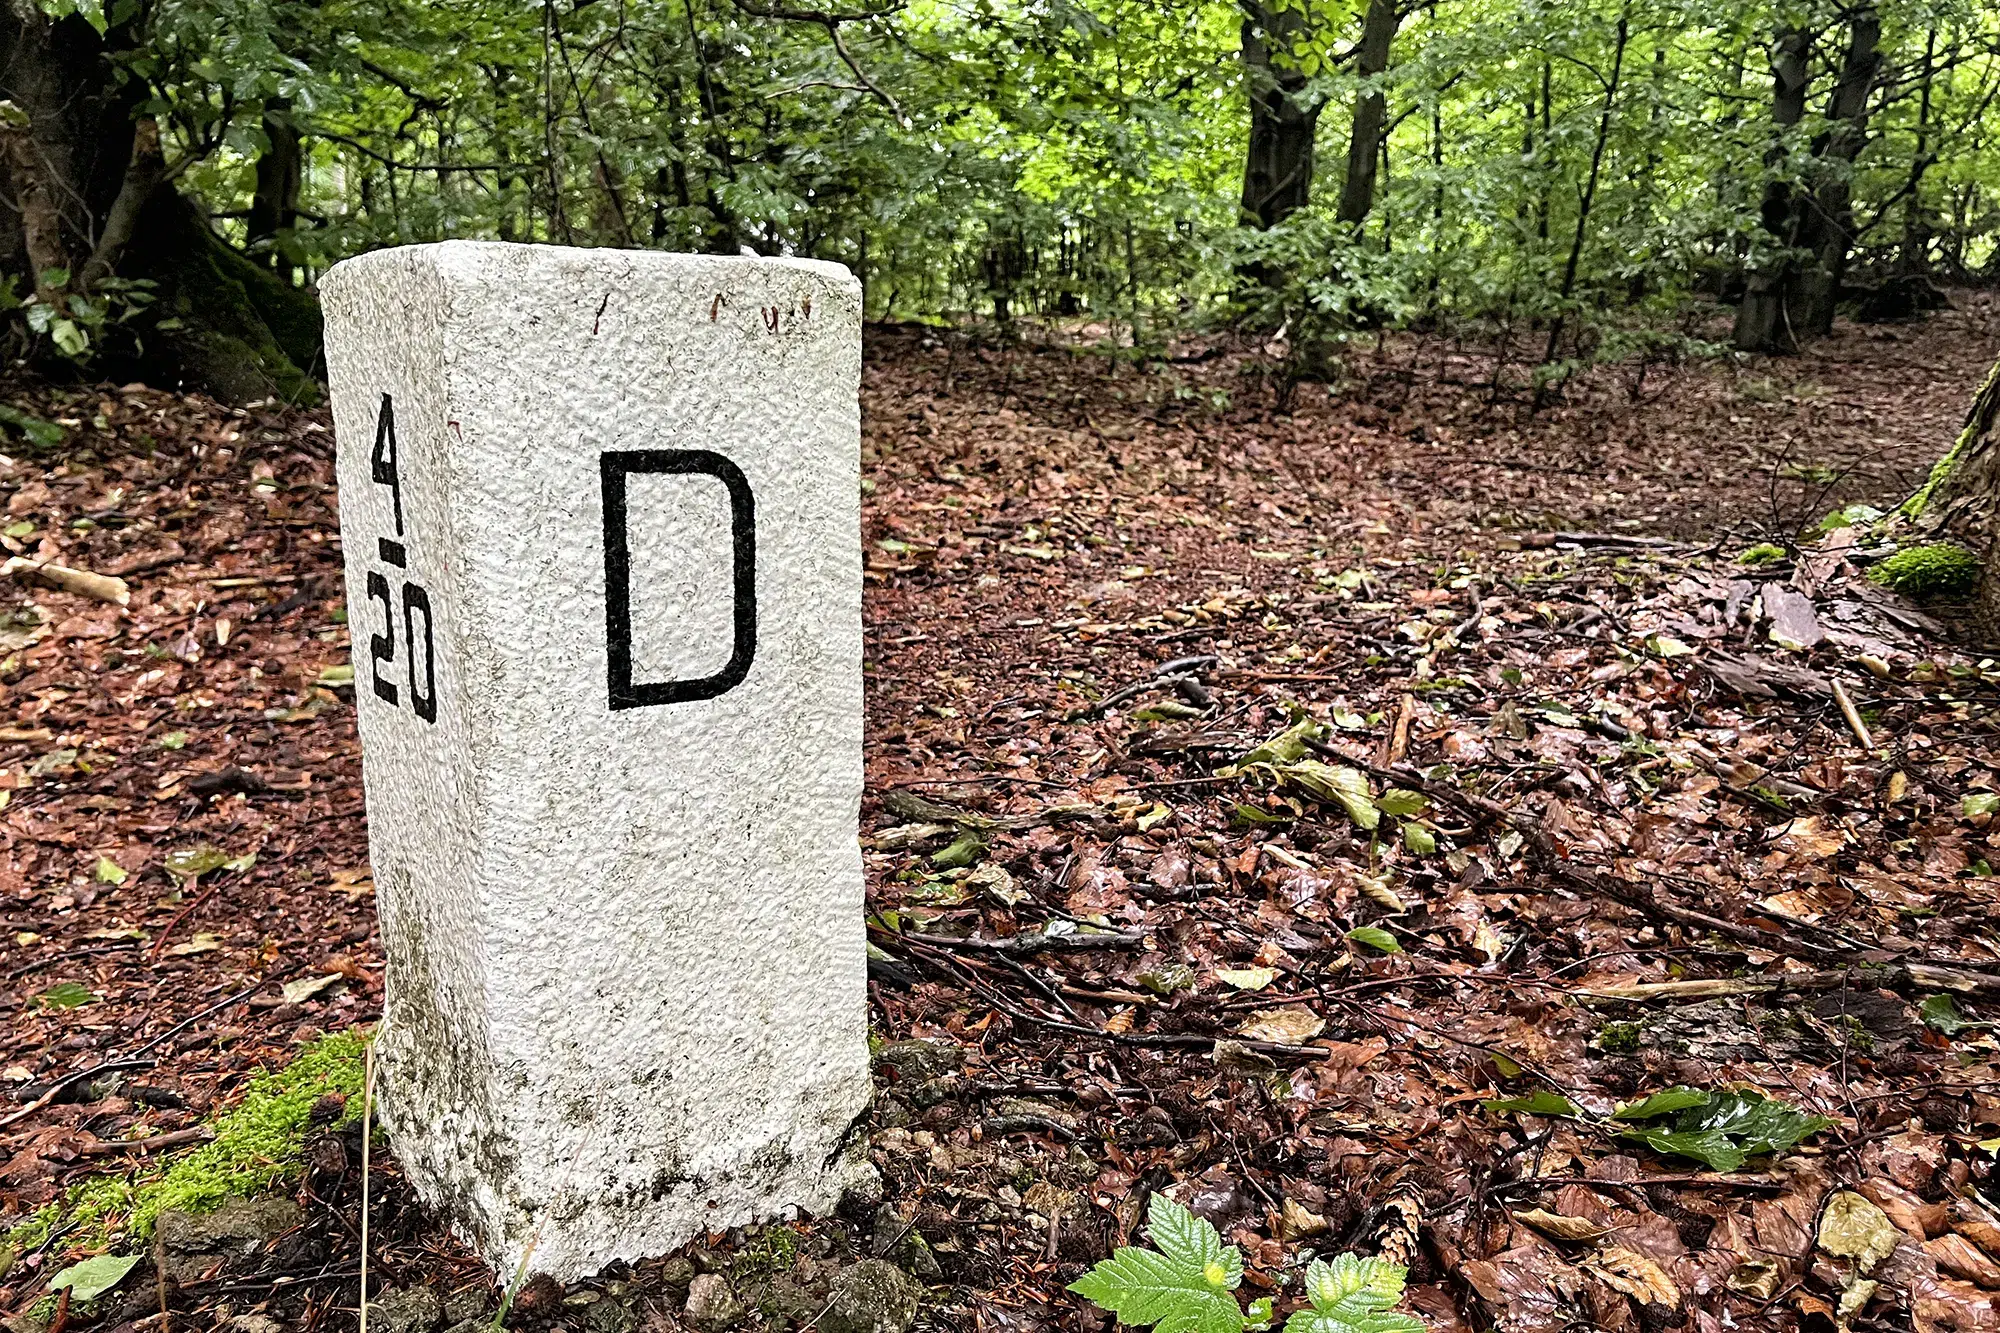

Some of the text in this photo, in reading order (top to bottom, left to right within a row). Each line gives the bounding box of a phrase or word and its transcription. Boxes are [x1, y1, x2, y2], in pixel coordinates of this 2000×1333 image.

[371, 392, 404, 537] 4
[367, 571, 437, 725] 20
[600, 449, 757, 711] D
